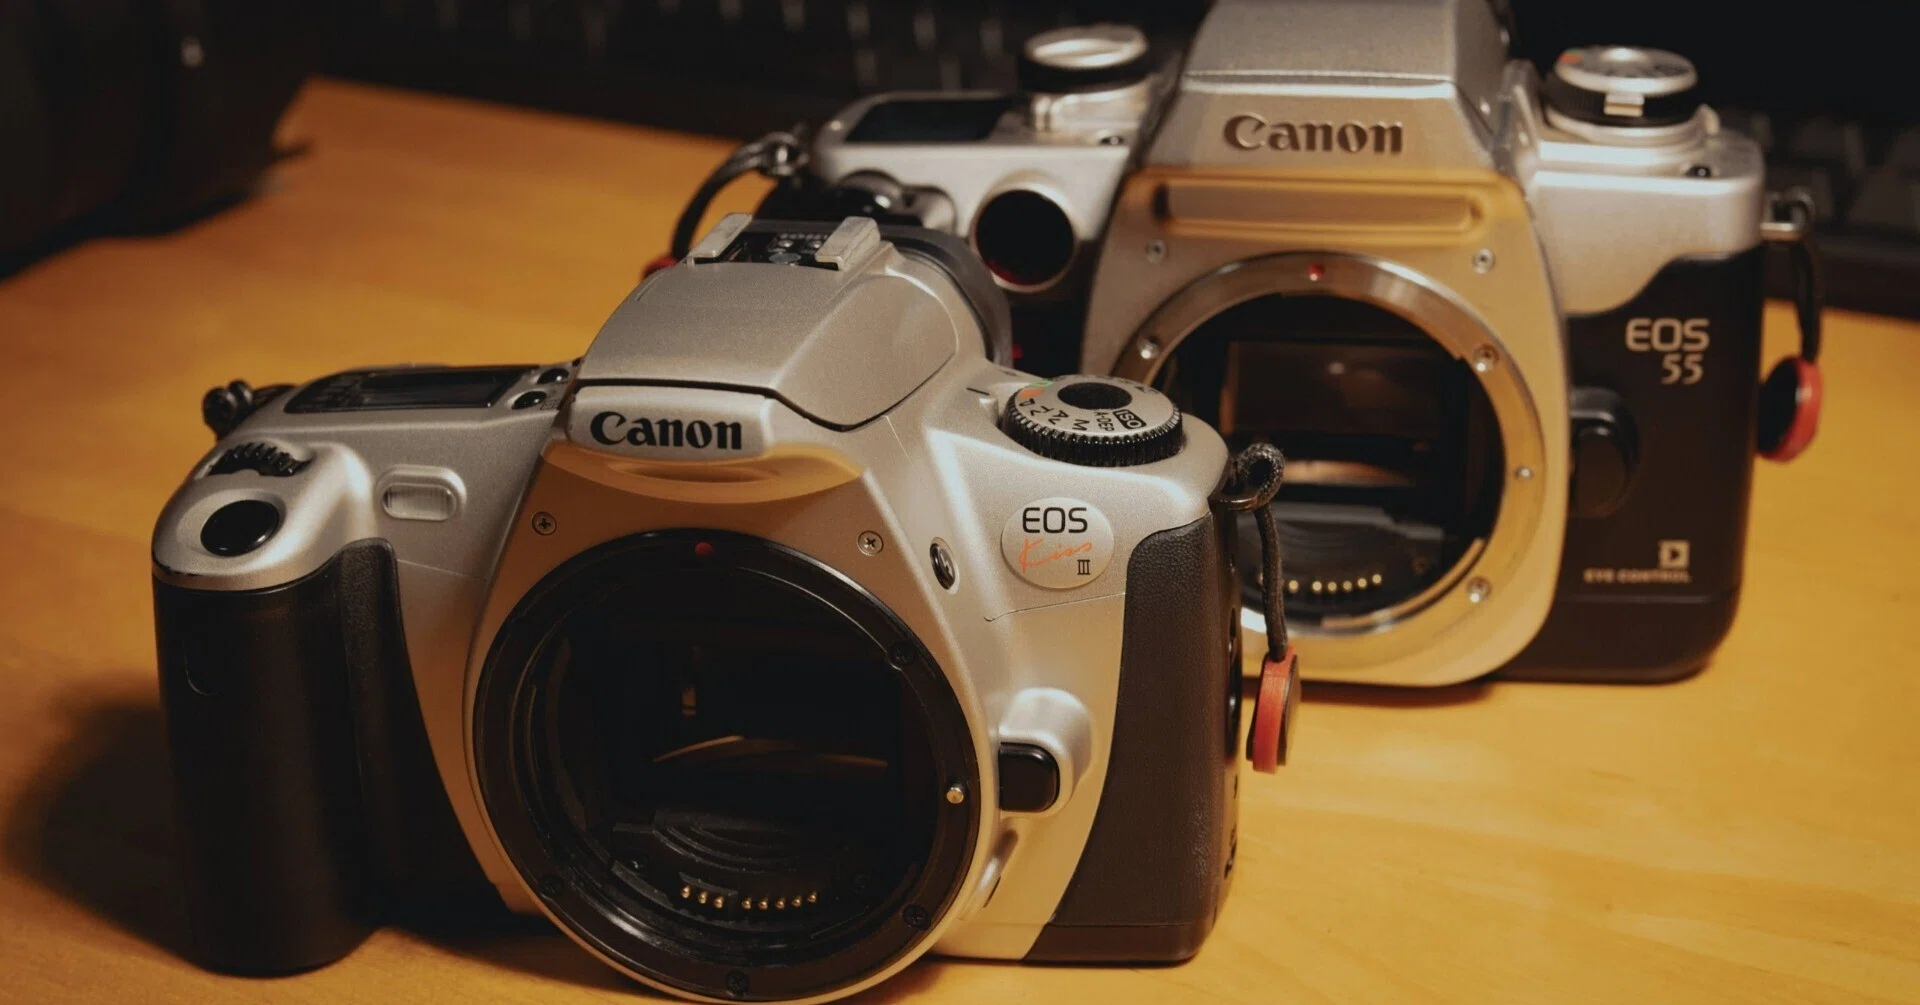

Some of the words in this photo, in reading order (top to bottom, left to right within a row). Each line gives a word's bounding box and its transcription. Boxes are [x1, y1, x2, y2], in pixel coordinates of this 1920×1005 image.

[1223, 113, 1403, 155] Canon
[1625, 318, 1710, 351] EOS
[1660, 352, 1704, 385] 55
[590, 411, 742, 450] Canon
[1072, 419, 1090, 431] M
[1115, 410, 1144, 429] ISO
[1022, 507, 1088, 533] EOS
